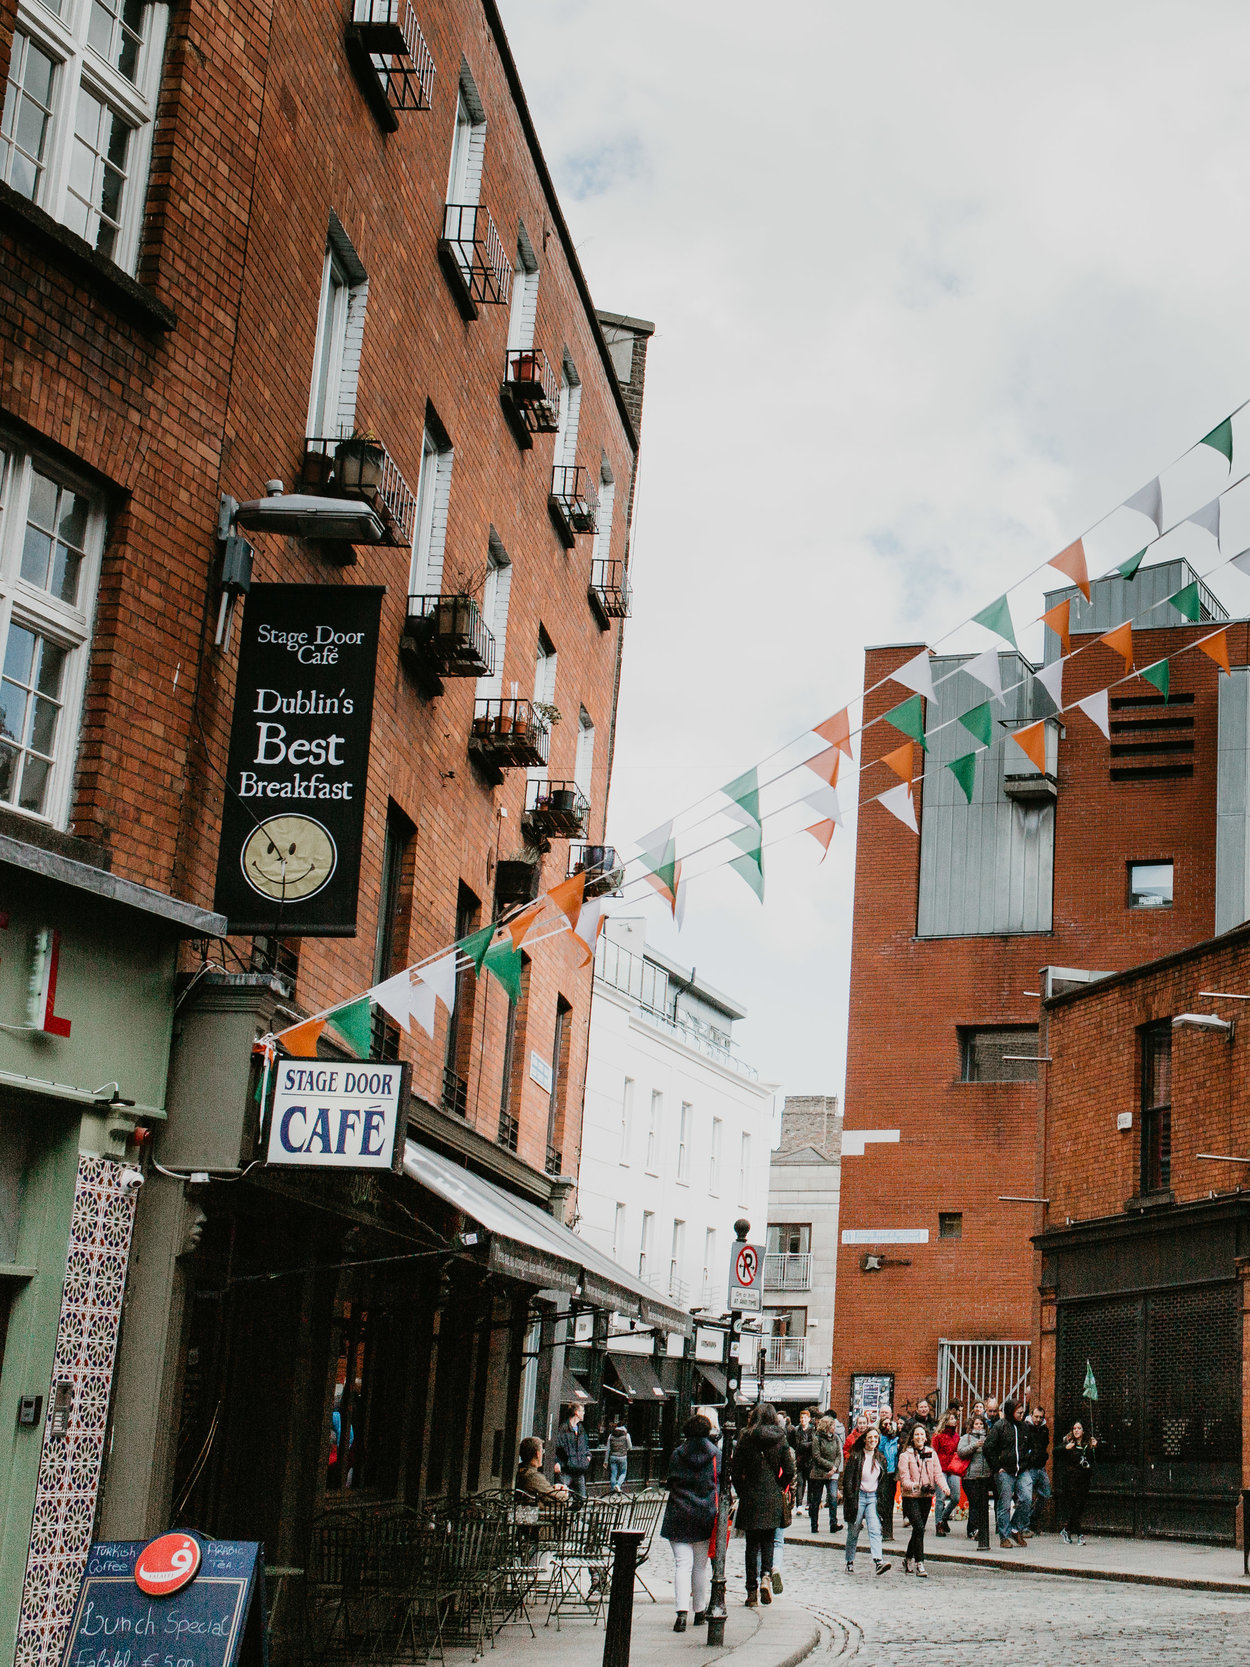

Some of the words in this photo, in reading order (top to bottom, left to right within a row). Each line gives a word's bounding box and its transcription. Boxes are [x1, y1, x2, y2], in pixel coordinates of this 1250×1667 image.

[257, 624, 309, 651] Stage
[313, 625, 365, 645] Door
[297, 645, 339, 665] Café
[253, 688, 354, 715] Dublin's
[253, 721, 345, 766] Best
[238, 771, 353, 800] Breakfast
[284, 1069, 339, 1092] STAGE
[343, 1072, 393, 1095] DOOR
[280, 1104, 386, 1157] CAFÉ
[88, 1559, 128, 1575] Coffee
[80, 1601, 155, 1636] Lunch
[164, 1610, 231, 1640] Special
